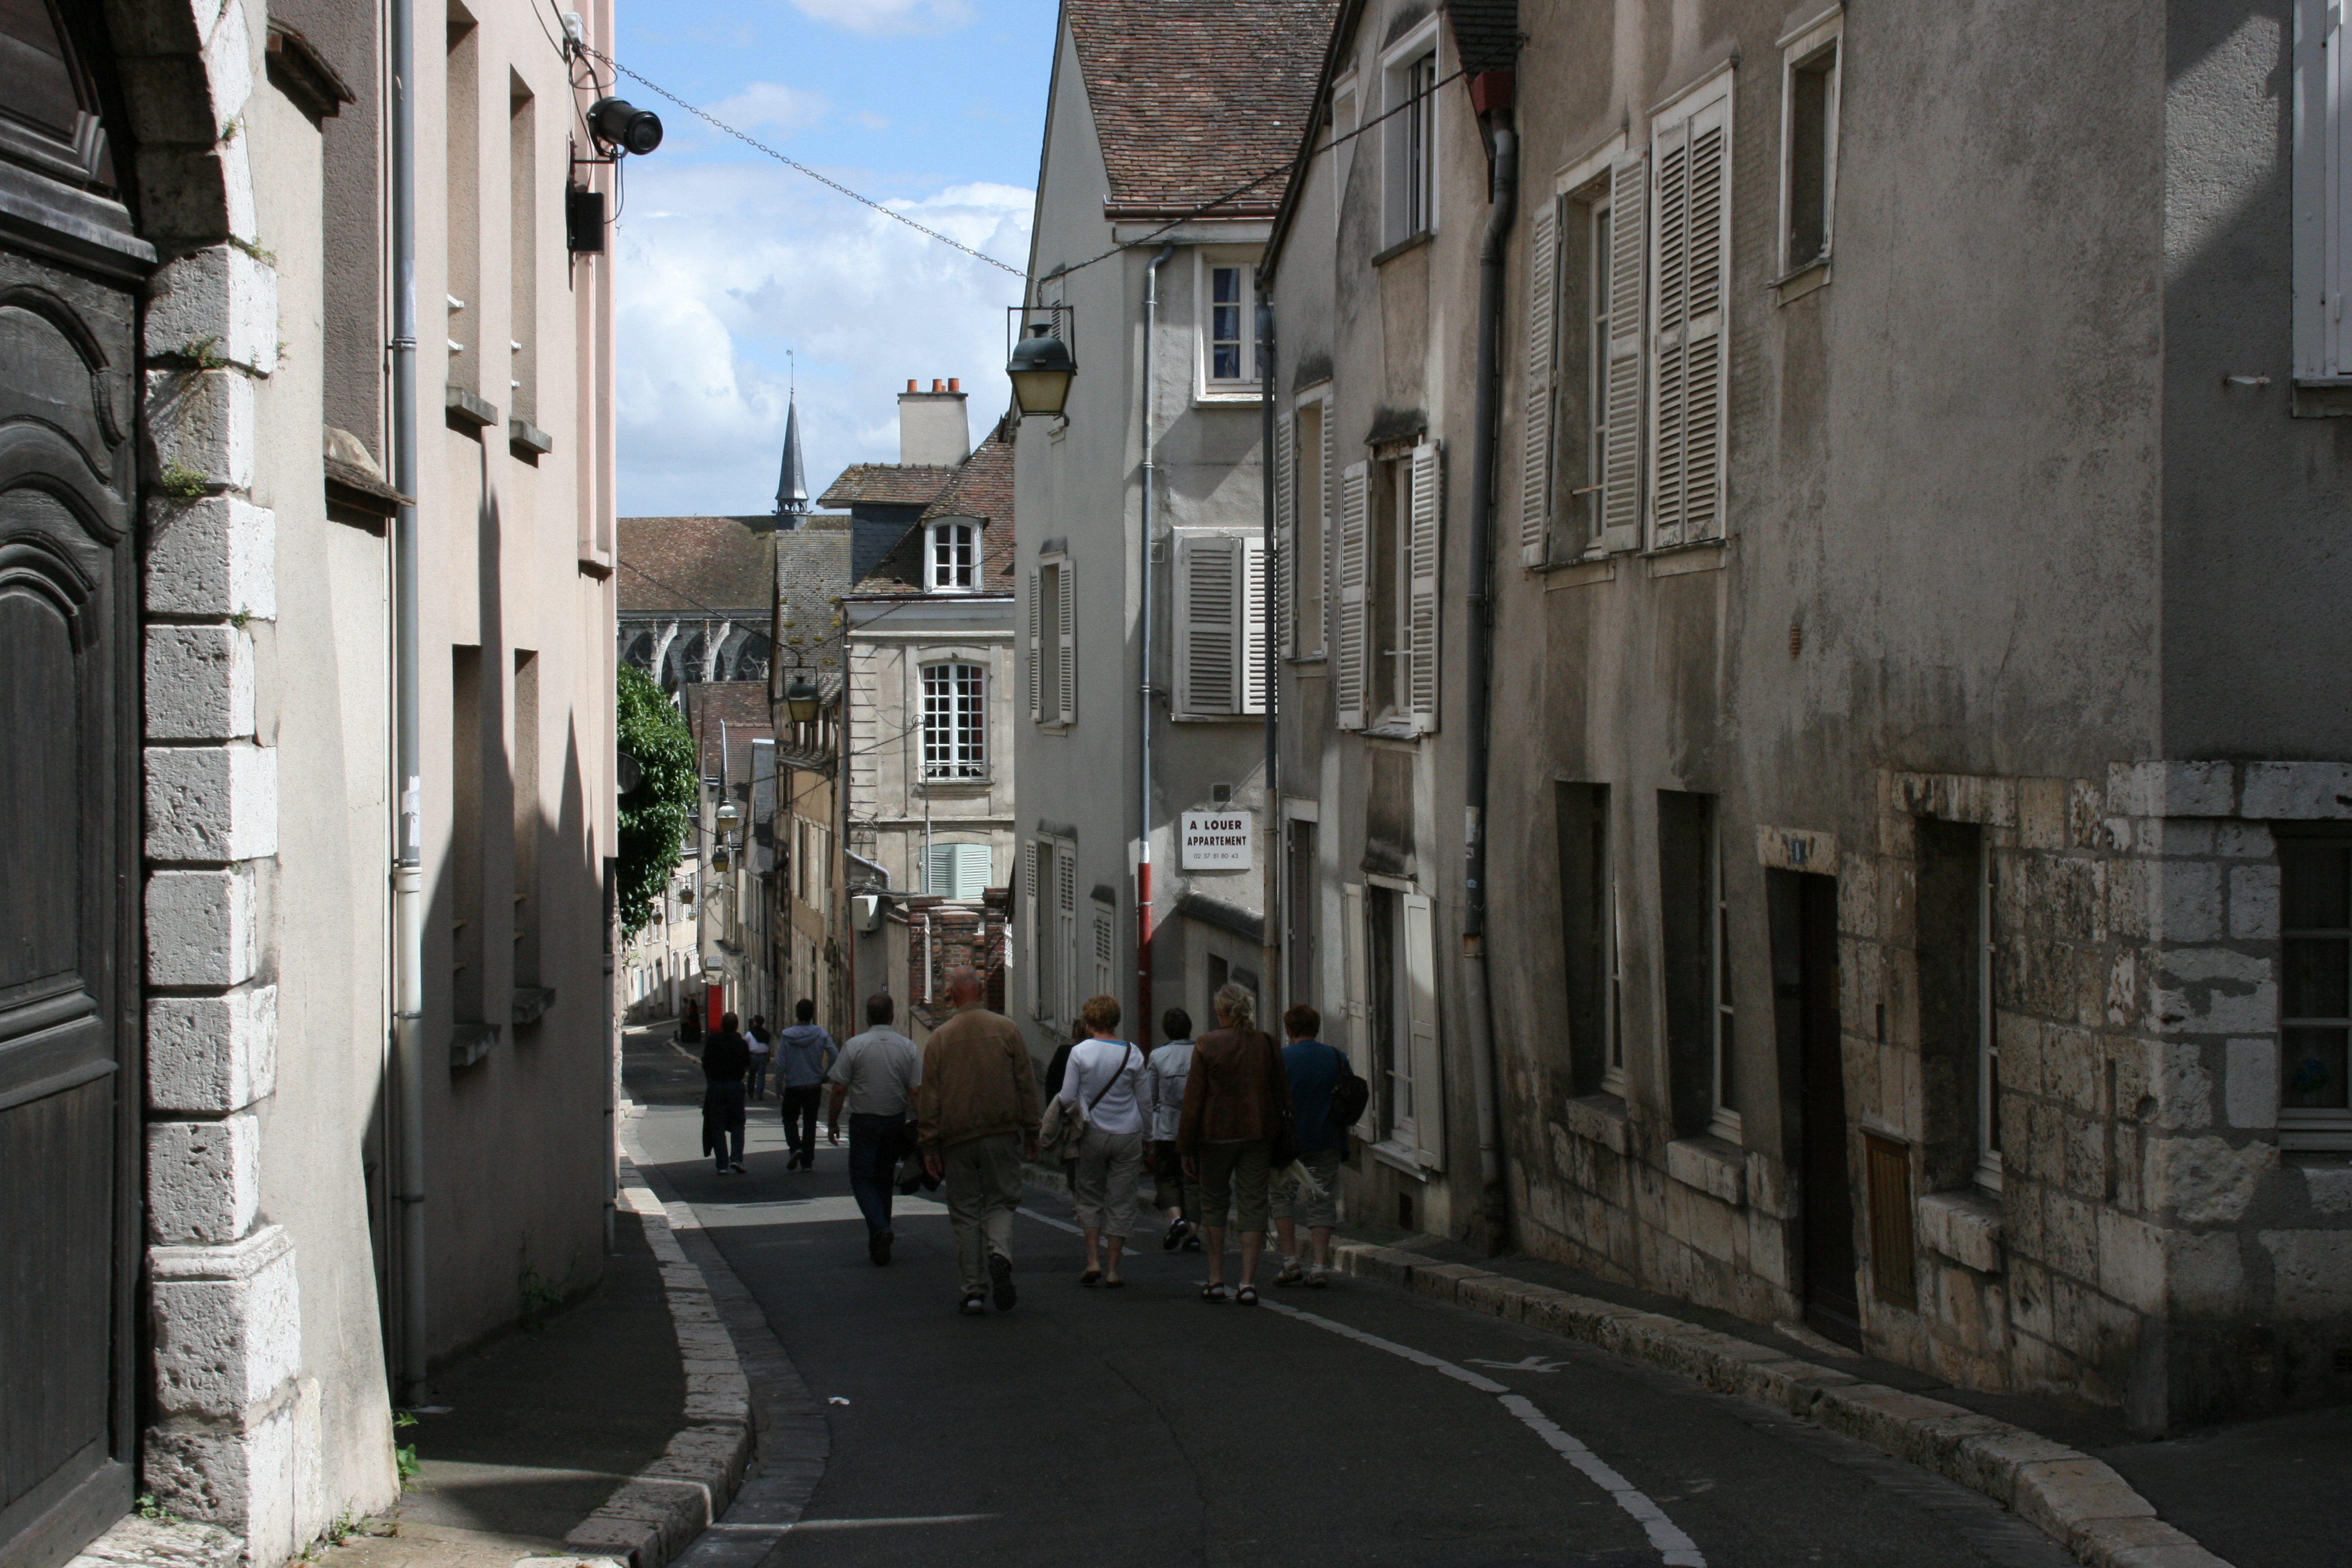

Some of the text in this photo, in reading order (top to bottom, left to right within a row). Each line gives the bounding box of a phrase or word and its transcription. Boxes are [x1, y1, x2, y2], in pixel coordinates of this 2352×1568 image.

[1190, 820, 1242, 830] A LOUER
[1187, 836, 1246, 846] APPARTEMENT
